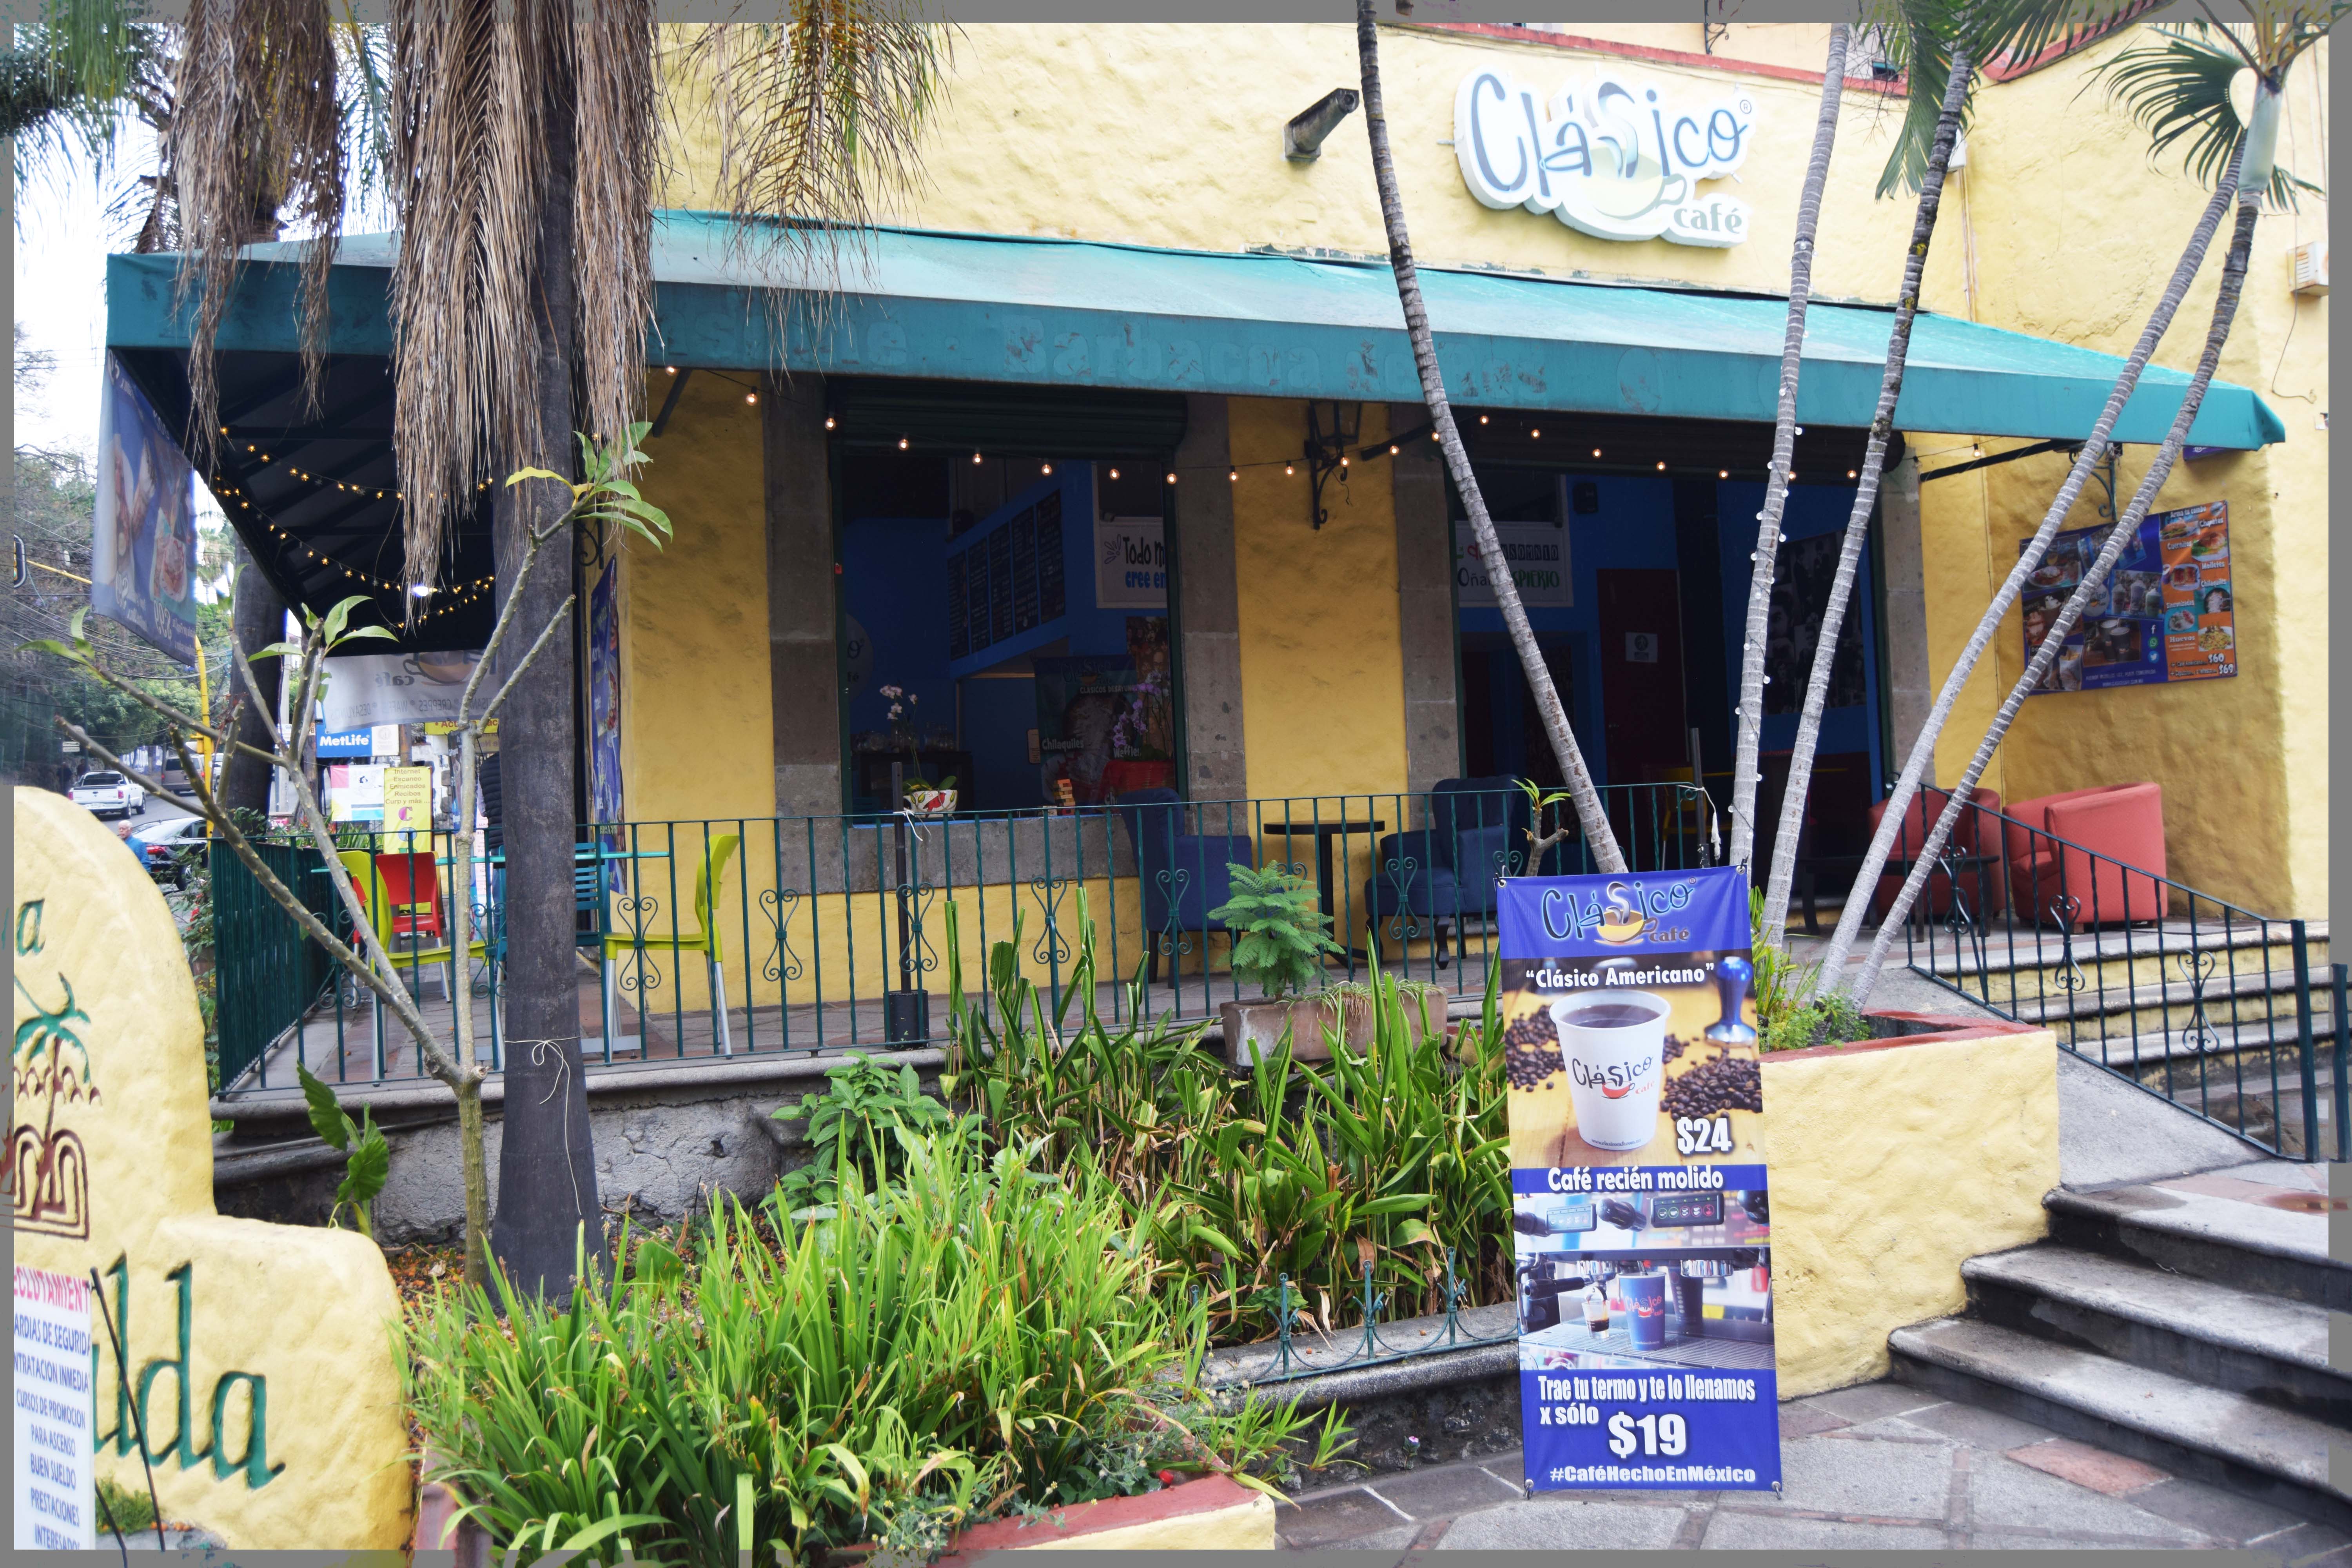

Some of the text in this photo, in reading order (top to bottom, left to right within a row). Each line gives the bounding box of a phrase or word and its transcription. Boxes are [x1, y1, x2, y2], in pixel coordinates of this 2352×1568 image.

[1673, 202, 1742, 234] café
[1122, 536, 1151, 565] Todo
[1125, 570, 1167, 589] cree en
[319, 734, 369, 746] MetLife
[1042, 737, 1084, 752] Chilaquiles
[1648, 927, 1690, 942] café
[1676, 1116, 1732, 1155] $24
[1548, 1165, 1724, 1191] Café recién molido
[43, 1320, 53, 1347] DE
[59, 1364, 90, 1394] INMEDIA
[1539, 1374, 1756, 1403] Trae tu termo y te lo llenamos
[16, 1389, 86, 1430] CURSOS DE PROMOCION
[1540, 1402, 1599, 1425] x sólo
[31, 1424, 76, 1458] PARA ASCENSO
[1608, 1411, 1687, 1459] $19
[31, 1452, 76, 1491] BUEN SUELDO
[1550, 1464, 1756, 1483] #CaféHechoEnMéxico
[31, 1486, 80, 1528] PRESTACIONES
